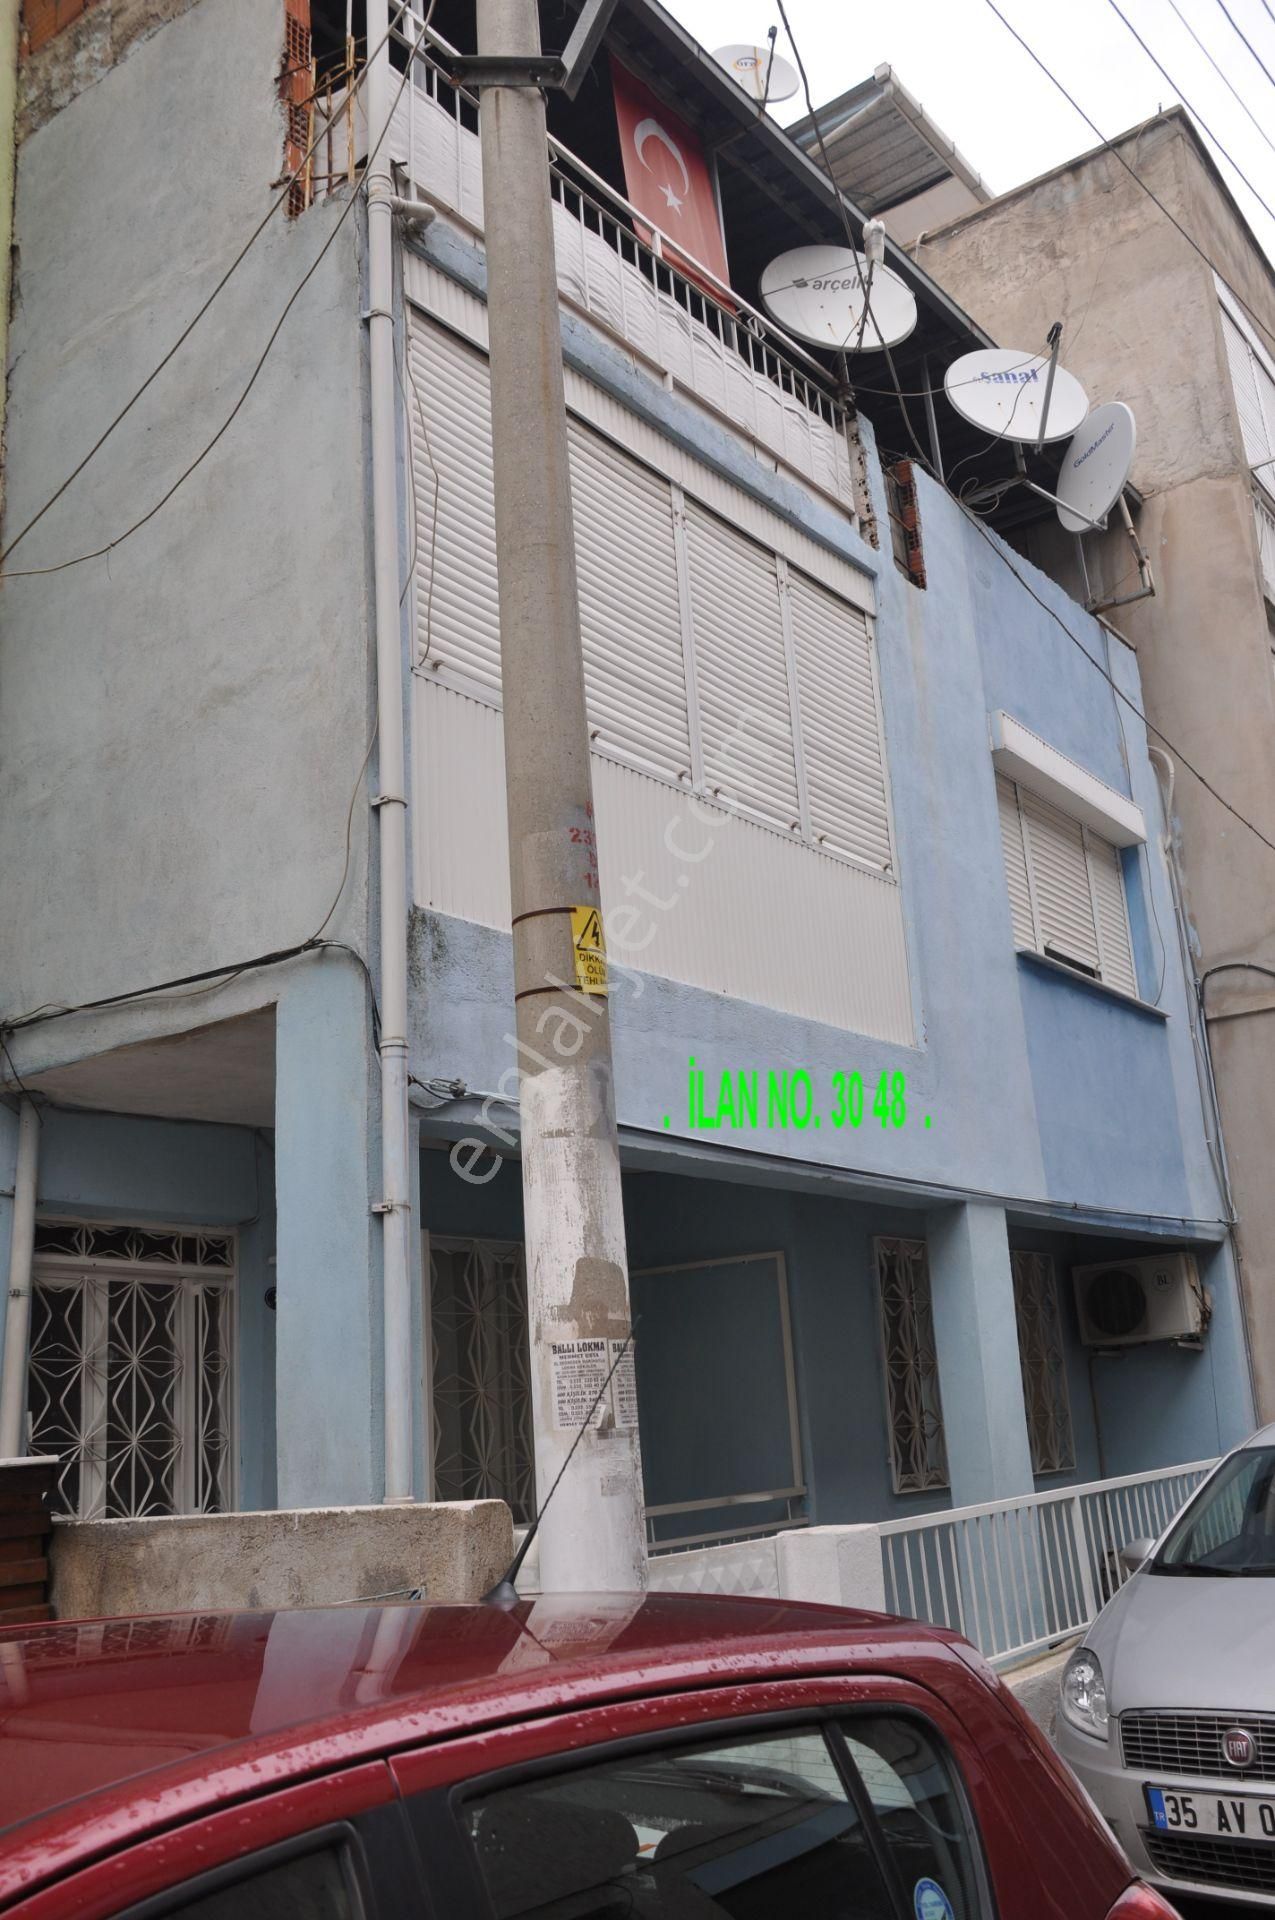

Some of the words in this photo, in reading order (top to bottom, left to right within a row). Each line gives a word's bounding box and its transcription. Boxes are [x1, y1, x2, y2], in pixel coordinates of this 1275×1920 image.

[552, 1343, 575, 1355] BALLI
[577, 1341, 605, 1352] LOKMA
[1228, 1740, 1249, 1757] FIAT
[1154, 1811, 1166, 1821] TR
[1165, 1795, 1197, 1828] 35
[1217, 1799, 1245, 1834] AV
